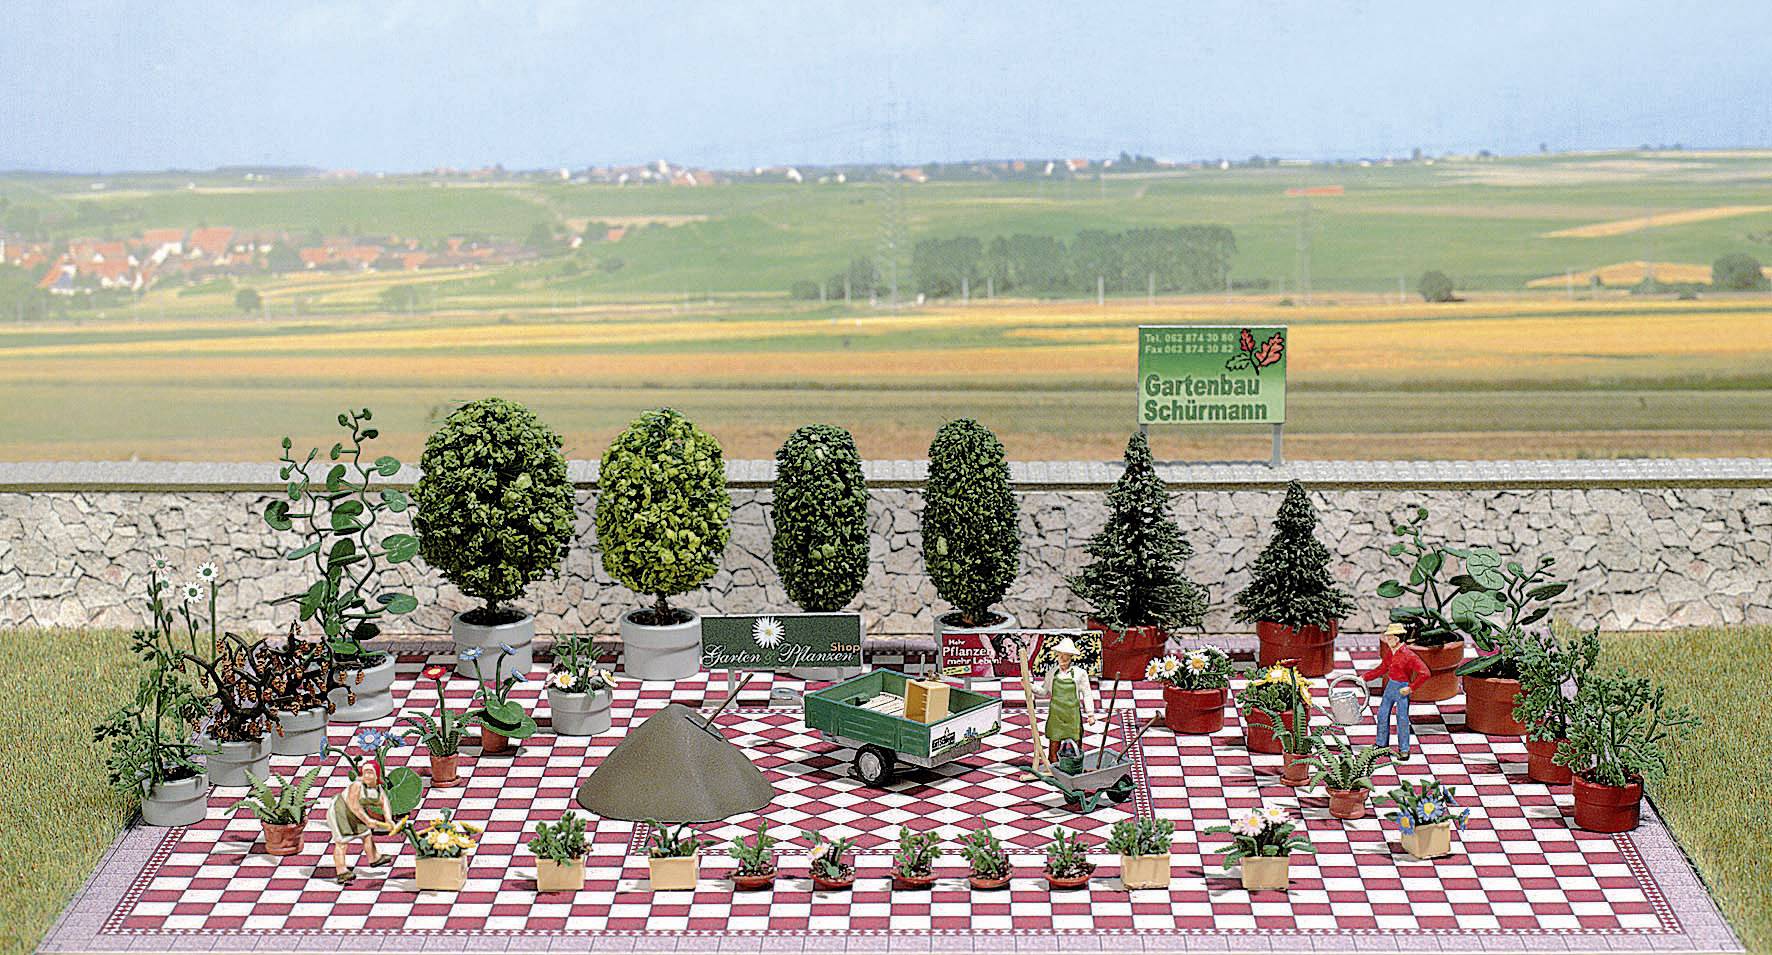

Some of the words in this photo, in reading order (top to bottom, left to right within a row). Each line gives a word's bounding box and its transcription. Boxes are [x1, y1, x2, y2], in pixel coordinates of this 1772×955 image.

[1164, 333, 1183, 343] 062
[1185, 333, 1204, 343] 874
[1207, 333, 1219, 343] 30
[1145, 345, 1162, 353] Fax
[1164, 344, 1183, 353] 062
[1185, 344, 1204, 353] 874
[1145, 374, 1260, 397] Gartenbau
[1144, 399, 1267, 421] Schürmann
[830, 642, 861, 654] Shop
[943, 646, 994, 657] Pflanzen
[702, 643, 762, 667] Garten
[777, 643, 856, 668] Pflanzen
[947, 657, 971, 665] mehr
